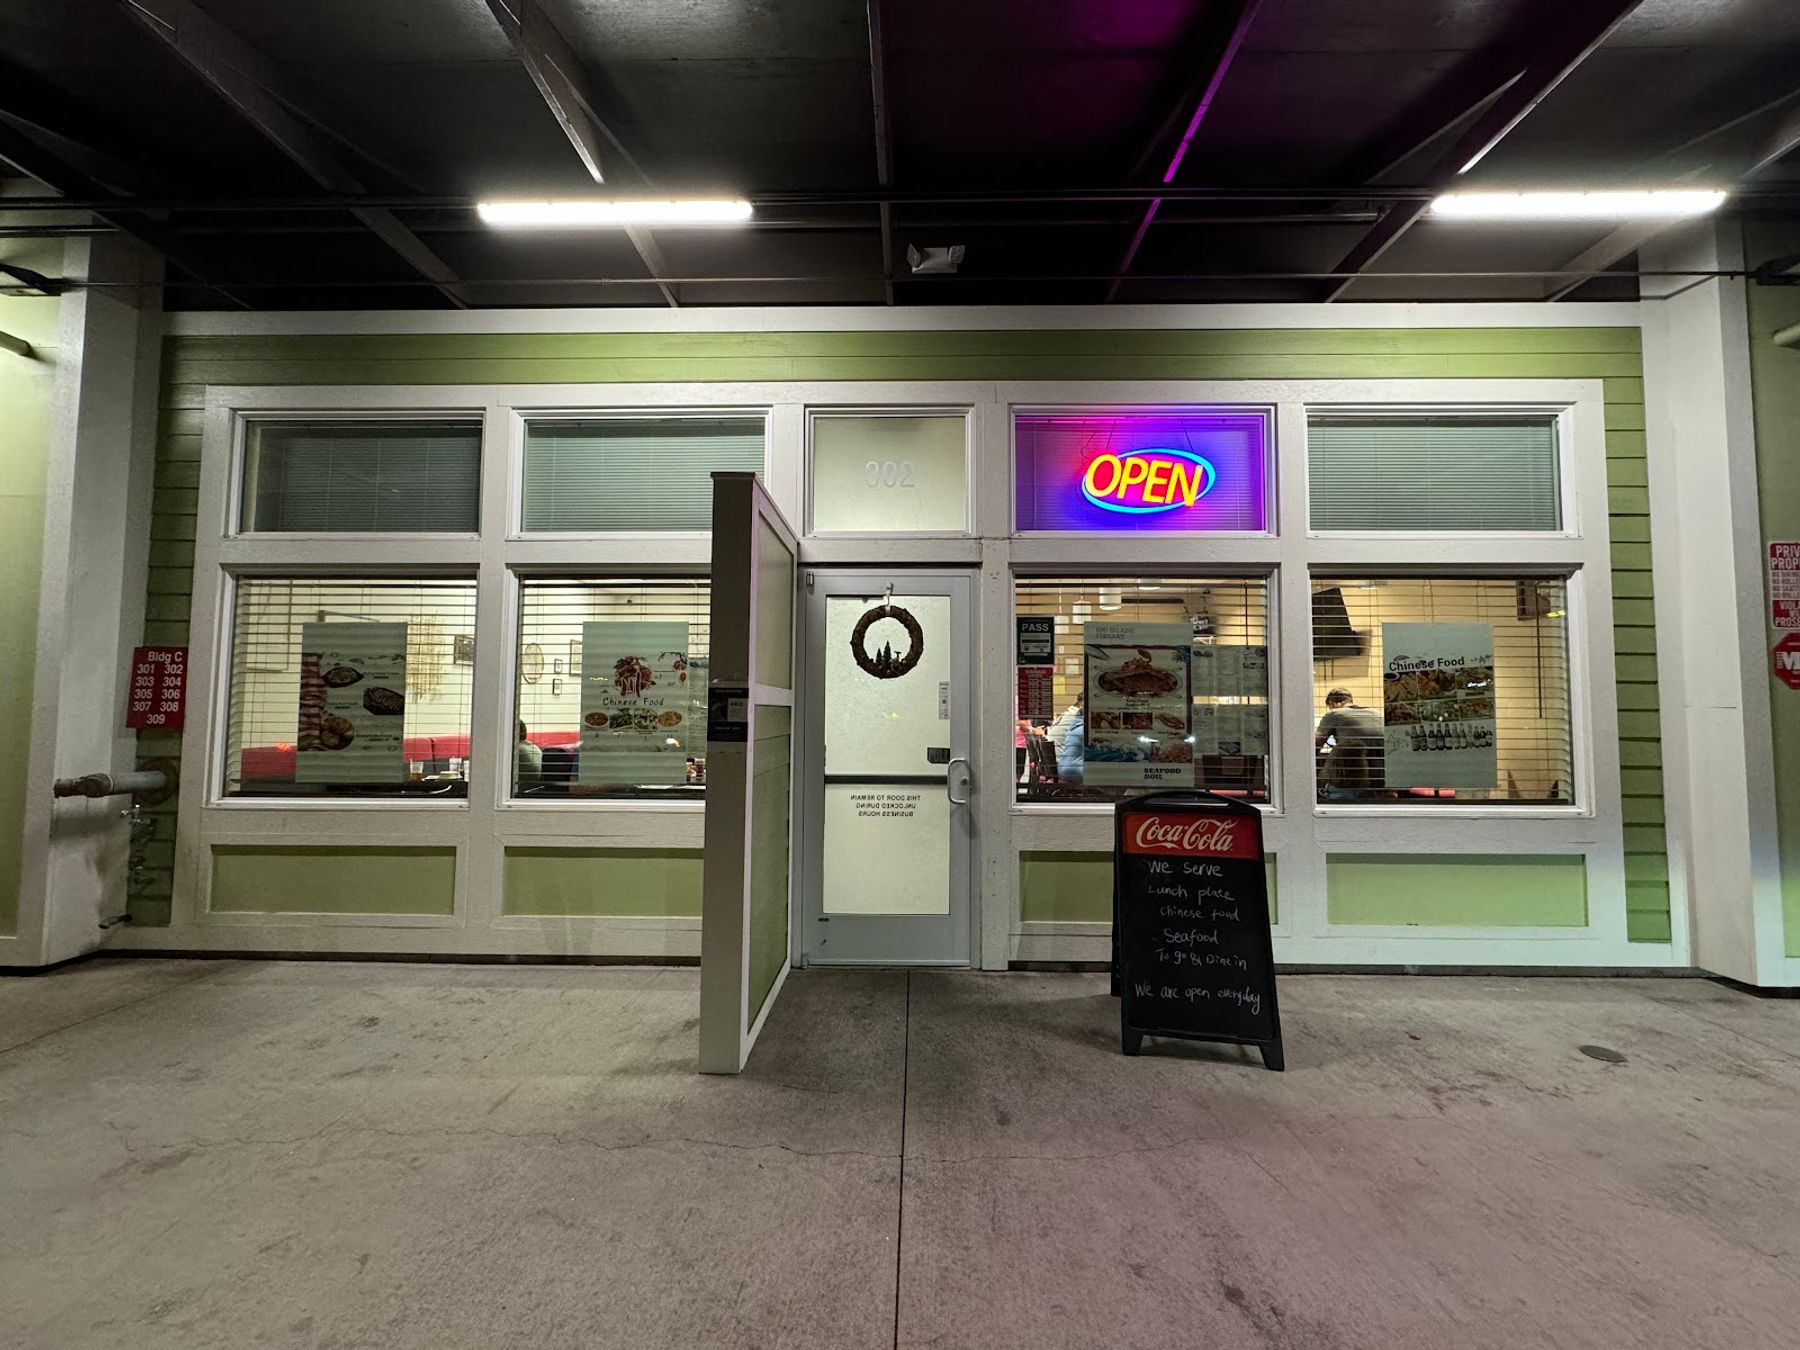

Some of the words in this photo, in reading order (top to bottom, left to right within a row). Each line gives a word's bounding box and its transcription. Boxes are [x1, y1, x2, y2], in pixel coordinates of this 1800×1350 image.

[865, 460, 915, 488] 302
[1084, 453, 1204, 507] OPEN
[1022, 623, 1049, 632] PASS
[148, 651, 172, 664] Bldg
[174, 651, 184, 662] C
[1389, 659, 1435, 672] Chinese
[1437, 656, 1465, 667] Food
[137, 663, 155, 674] 301
[164, 664, 183, 675] 302
[135, 676, 154, 687] 303
[162, 676, 182, 687] 304
[134, 688, 153, 699] 305
[161, 689, 180, 699] 306
[132, 701, 151, 711] 307
[159, 701, 179, 712] 308
[603, 697, 637, 706] Chinese
[643, 697, 665, 706] Food
[146, 713, 165, 725] 309
[1136, 817, 1238, 851] Coca-Cola
[1149, 861, 1174, 874] We
[1149, 885, 1187, 898] Lunch
[1211, 908, 1240, 920] food
[1164, 928, 1219, 946] Seafood
[1156, 948, 1169, 961] To
[1174, 950, 1187, 964] go
[1234, 955, 1246, 970] in
[1135, 982, 1154, 997] We
[1160, 986, 1180, 998] are
[1185, 987, 1210, 1002] open
